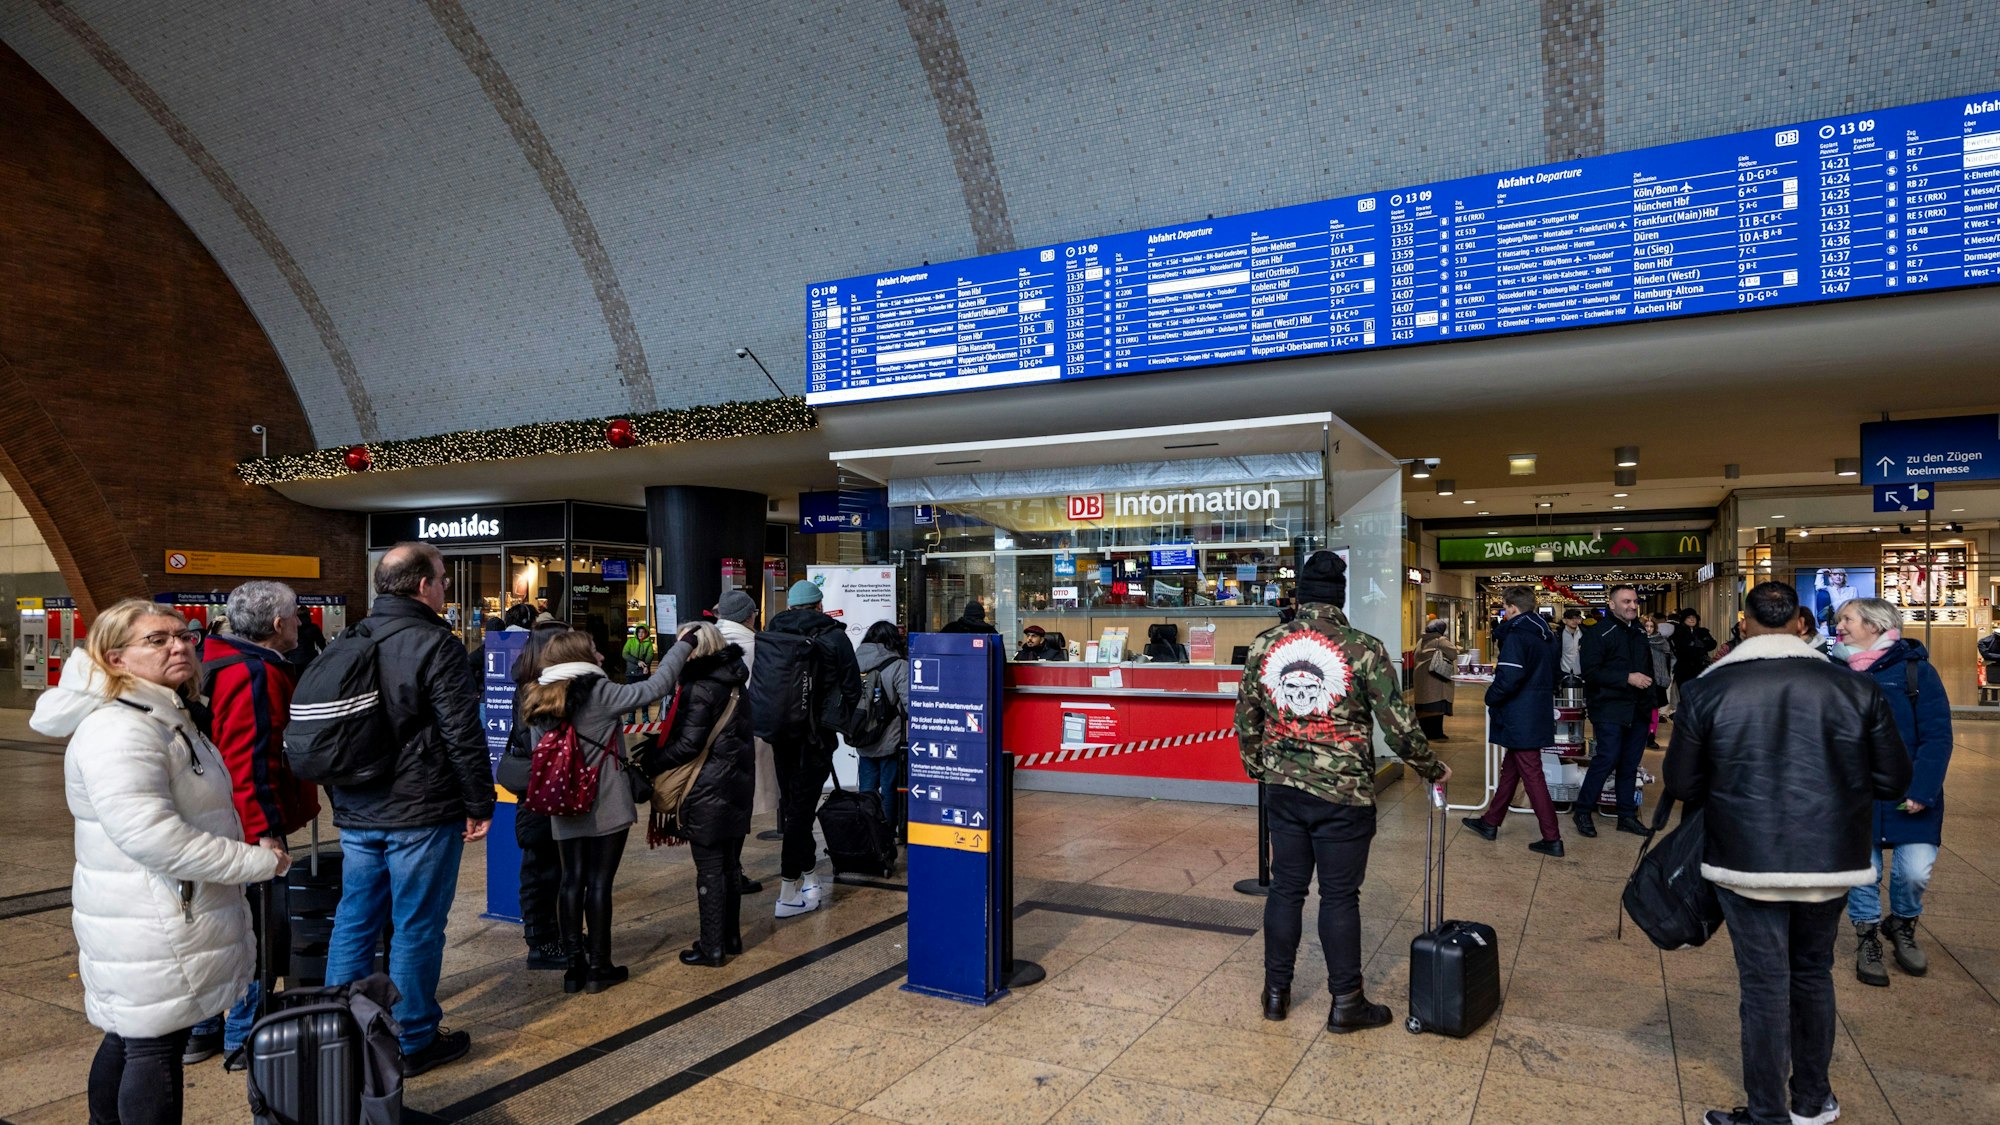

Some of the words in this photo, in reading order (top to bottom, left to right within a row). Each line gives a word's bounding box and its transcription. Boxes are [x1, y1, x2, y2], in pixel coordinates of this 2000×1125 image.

[1840, 123, 1855, 135] 13
[1859, 120, 1874, 131] 09
[1778, 131, 1796, 145] DB
[1822, 158, 1849, 170] 14:21
[1497, 175, 1534, 189] Abfahrt
[1536, 169, 1582, 183] Departure
[1822, 173, 1850, 186] 14:24
[1918, 179, 1928, 187] 27
[1406, 193, 1417, 203] 13
[1420, 191, 1432, 201] 09
[1634, 185, 1678, 198] Köln/Bonn
[1822, 188, 1849, 201] 14:25
[1924, 192, 1946, 202] (RRX)
[1634, 201, 1672, 212] München
[1674, 196, 1689, 206] Hbf
[1984, 202, 1998, 210] Hbf
[1822, 204, 1849, 217] 14:31
[1924, 208, 1946, 218] (RRX)
[1634, 207, 1718, 227] Frankfurt(Main)Hbf
[1392, 223, 1413, 233] 13:52
[1822, 220, 1850, 232] 14:32
[1148, 232, 1176, 244] Abfahrt
[1177, 228, 1213, 240] Departure
[1497, 234, 1538, 245] Siegburg/Bonn
[1543, 229, 1573, 238] Montabaur
[1579, 222, 1617, 233] Frankfurt(M)
[1634, 232, 1659, 242] Düren
[1392, 236, 1413, 247] 13:55
[1822, 235, 1850, 248] 14:36
[1078, 246, 1087, 255] 13
[1088, 244, 1098, 253] 09
[1252, 242, 1296, 254] Bonn-Mehlem
[1634, 247, 1645, 256] Au
[1647, 243, 1674, 256] (Sieg)
[1392, 249, 1414, 260] 13:59
[1822, 251, 1850, 263] 14:37
[1252, 259, 1270, 267] Essen
[1271, 255, 1283, 264] Hbf
[1634, 262, 1655, 270] Bonn
[1657, 257, 1673, 268] Hbf
[1251, 266, 1299, 279] Leer(Ostfriesl)
[1392, 263, 1414, 273] 14:00
[1822, 267, 1850, 278] 14:42
[876, 276, 899, 287] Abfahrt
[900, 273, 928, 283] Departure
[1067, 271, 1084, 281] 13:36
[1392, 276, 1413, 287] 14:01
[1634, 274, 1665, 285] Minden
[1667, 269, 1700, 282] (Westf)
[1919, 274, 1928, 282] 24
[821, 287, 828, 296] 13
[830, 286, 838, 294] 09
[1634, 285, 1704, 300] Hamburg-Altona
[1822, 282, 1850, 294] 14:47
[1252, 294, 1275, 304] Krefeld
[1276, 292, 1288, 301] Hbf
[1067, 307, 1084, 316] 13:38
[1252, 308, 1264, 317] Kall
[1634, 304, 1664, 314] Aachen
[1666, 301, 1682, 310] Hbf
[1067, 319, 1084, 328] 13:42
[1273, 317, 1298, 328] (Westf)
[1300, 315, 1312, 324] Hbf
[970, 342, 996, 351] Hansaring
[1252, 341, 1328, 356] Wuppertal-Oberbarmen
[1923, 454, 1943, 463] den
[1947, 452, 1982, 463] Zügen
[1906, 465, 1970, 476] koelnmesse
[1909, 483, 1918, 502] 1
[1070, 495, 1102, 517] DB
[1116, 487, 1280, 516] Information
[418, 513, 499, 538] Leonidas
[1484, 541, 1514, 558] ZUG
[1564, 540, 1605, 557] MAC.
[1113, 562, 1120, 578] 1
[935, 702, 983, 710] Fahrkartenverkauf
